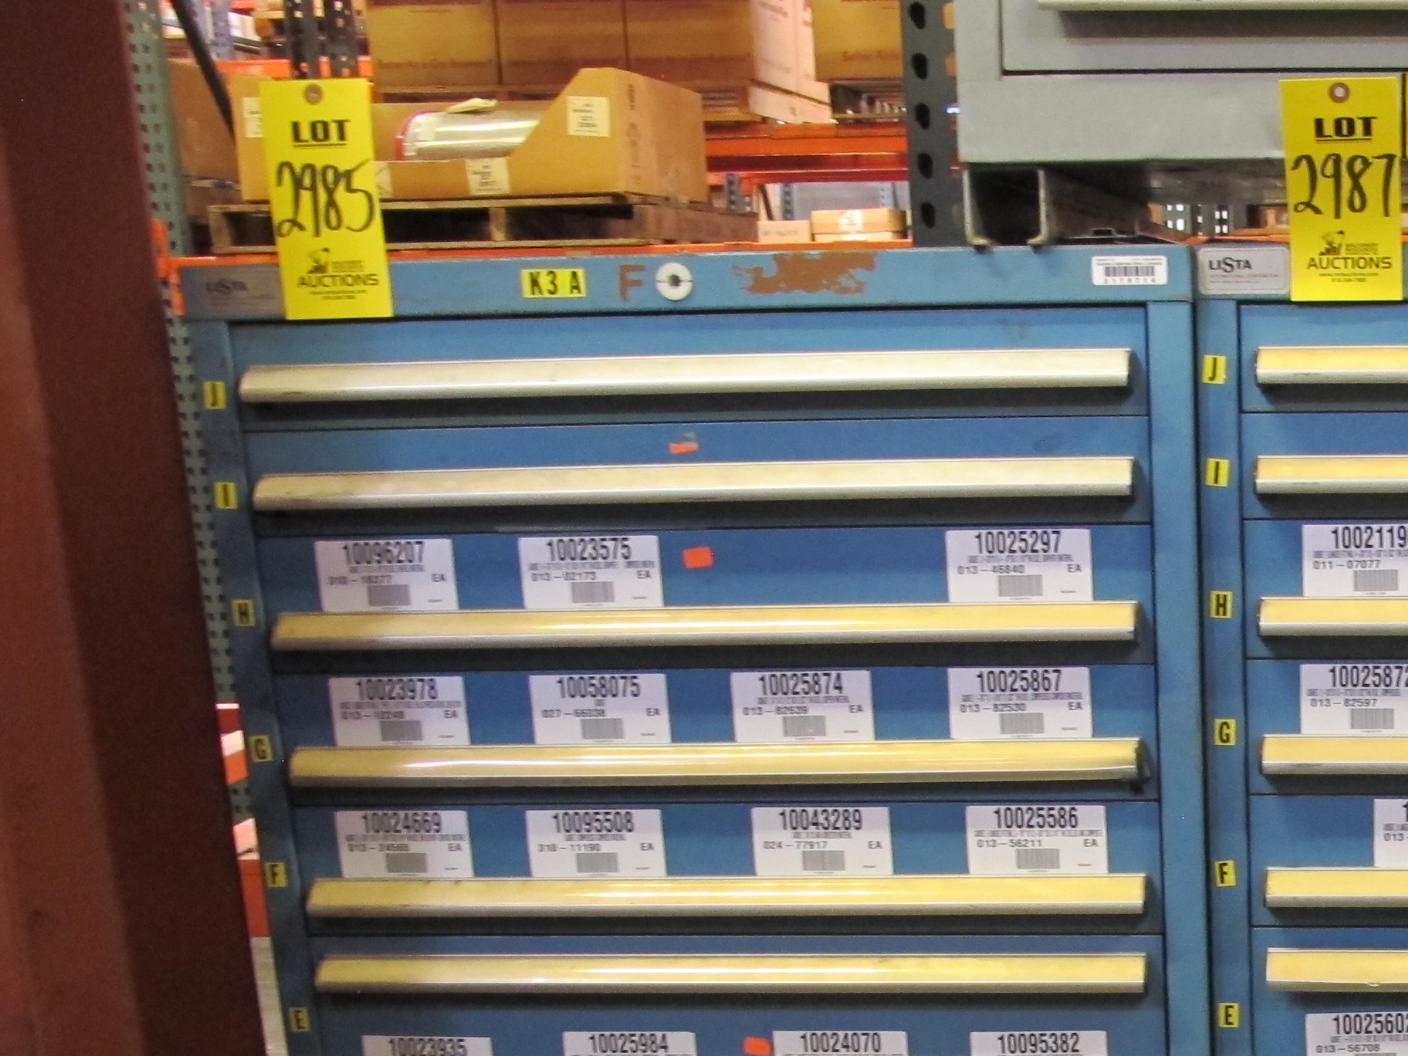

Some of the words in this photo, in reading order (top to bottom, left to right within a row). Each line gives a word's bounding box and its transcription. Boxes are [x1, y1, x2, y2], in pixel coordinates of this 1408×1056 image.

[292, 119, 350, 143] LOT
[1314, 116, 1376, 139] LOT
[1291, 152, 1397, 219] 2987
[277, 159, 375, 238] 2985
[1209, 257, 1252, 273] LISTA
[1306, 256, 1392, 270] AUCTIONS
[298, 274, 379, 288] AUCTIONS
[1208, 357, 1217, 381] J
[974, 532, 1061, 553] 10025297
[1067, 564, 1081, 573] EA
[1216, 594, 1227, 616] H
[557, 677, 640, 698] 10058075
[758, 673, 843, 695] 10025874
[976, 670, 1062, 692] 10025867
[646, 708, 660, 716] EA
[1068, 702, 1082, 710] EA
[1219, 722, 1230, 743] G
[552, 812, 634, 832] 10095508
[779, 809, 862, 830] 10043289
[993, 807, 1078, 828] 10025586
[868, 841, 882, 849] EA
[1084, 839, 1098, 847] EA
[1218, 863, 1228, 884] F
[1225, 1005, 1233, 1025] E
[589, 1034, 668, 1053] 10025984
[800, 1033, 881, 1053] 10024070
[998, 1033, 1079, 1054] 10095382
